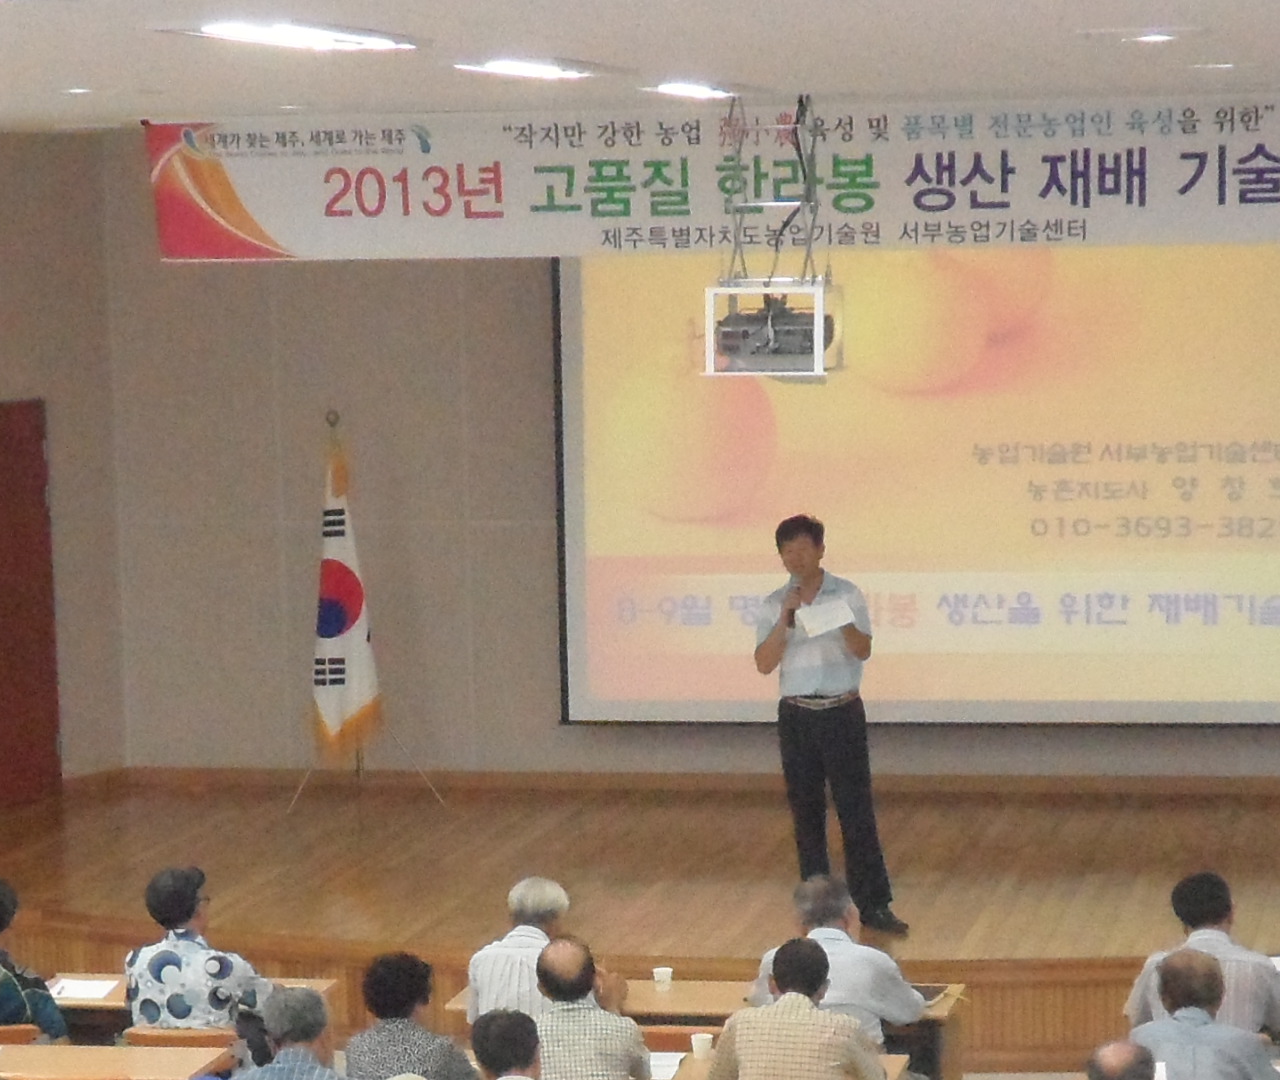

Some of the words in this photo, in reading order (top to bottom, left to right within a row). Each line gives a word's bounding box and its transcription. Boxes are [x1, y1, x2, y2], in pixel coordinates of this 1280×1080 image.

[352, 128, 377, 146] 가는
[381, 128, 406, 146] 제주
[597, 119, 643, 149] 강한
[655, 119, 702, 147] 농업
[808, 114, 854, 143] 육성
[867, 114, 890, 142] 및
[901, 112, 975, 141] 품목별
[988, 110, 1113, 139] 전문농업인
[1125, 106, 1201, 136] 육성을
[323, 160, 505, 220] 2013년
[530, 155, 692, 218] 고품질
[715, 151, 881, 215] 한라봉
[904, 149, 1017, 212] 생산
[1038, 146, 1147, 208] 재배
[899, 217, 1088, 246] 서부농업기술센터
[936, 590, 1042, 626] 생산을
[1058, 591, 1129, 626] 위한
